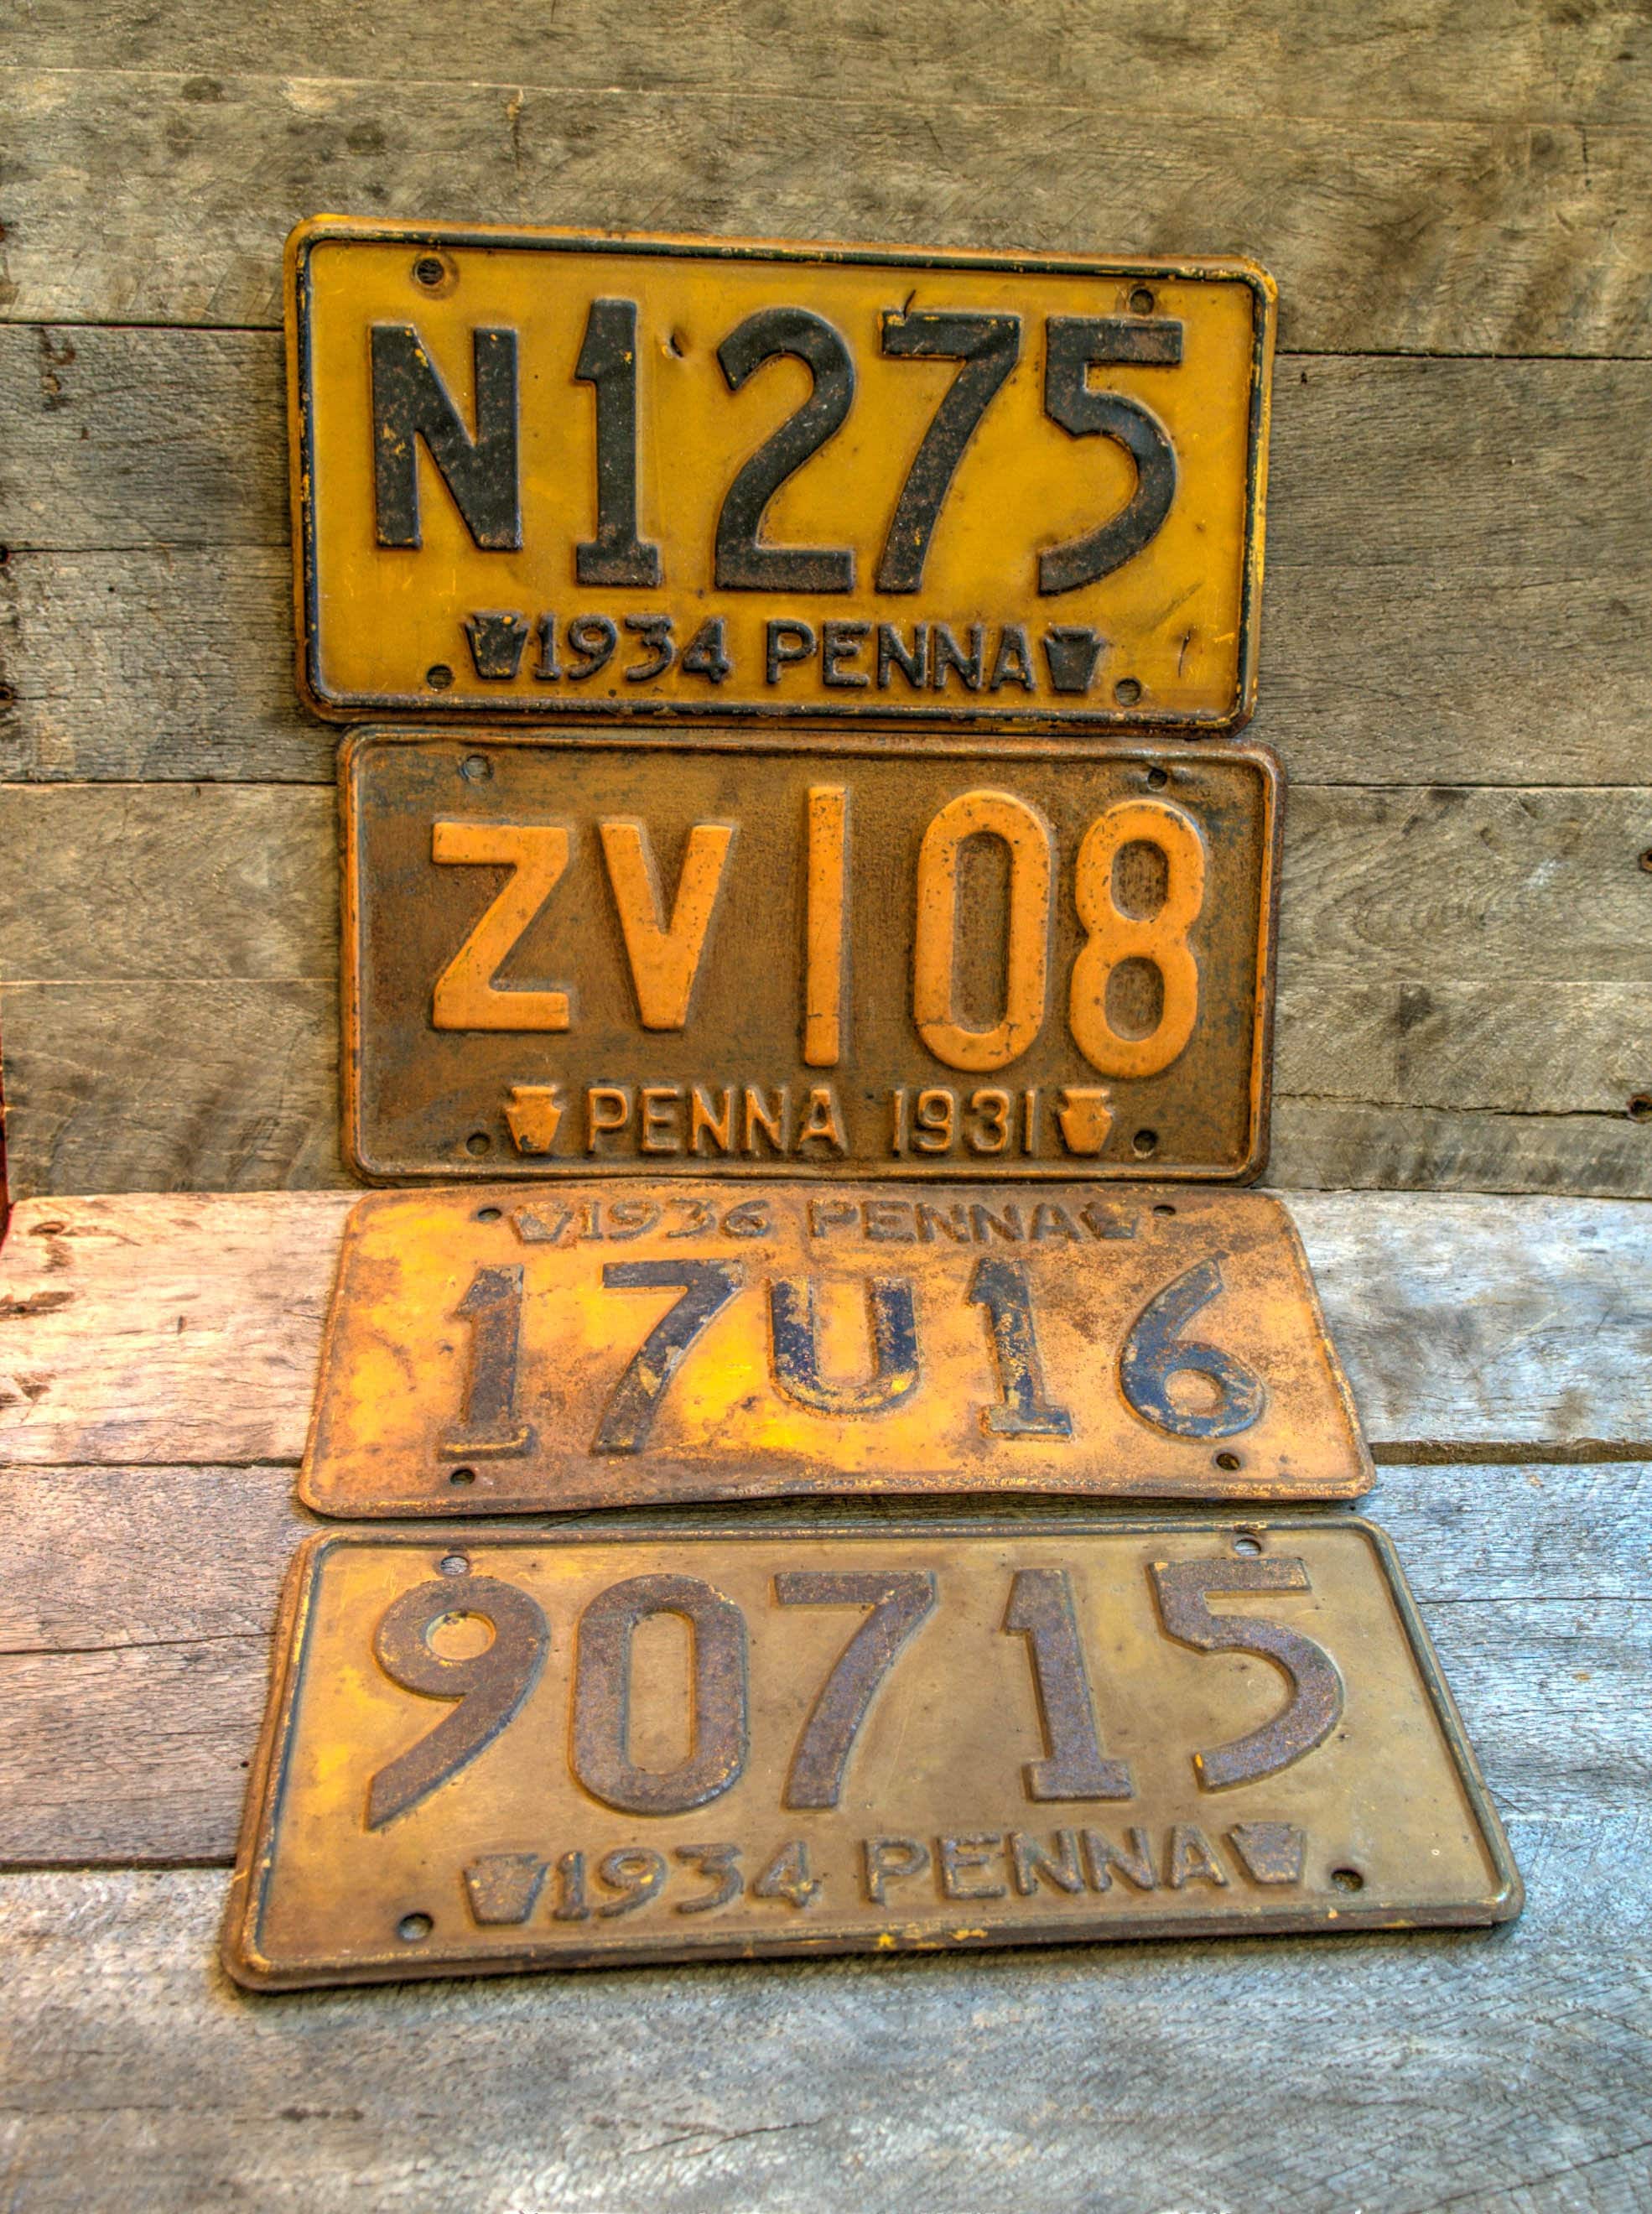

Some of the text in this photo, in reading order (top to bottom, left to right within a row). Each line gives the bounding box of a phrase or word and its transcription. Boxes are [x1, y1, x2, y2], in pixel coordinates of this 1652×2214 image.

[370, 298, 1186, 595] N1275
[532, 614, 1036, 693] 1934 PENNA
[587, 1085, 1037, 1156] PENNA 1931
[582, 1198, 1092, 1245] 1936 PENNA
[439, 1258, 1266, 1459] 17U16
[367, 1557, 1346, 1832] 90715
[553, 1826, 1230, 1920] 1934 PENNA
